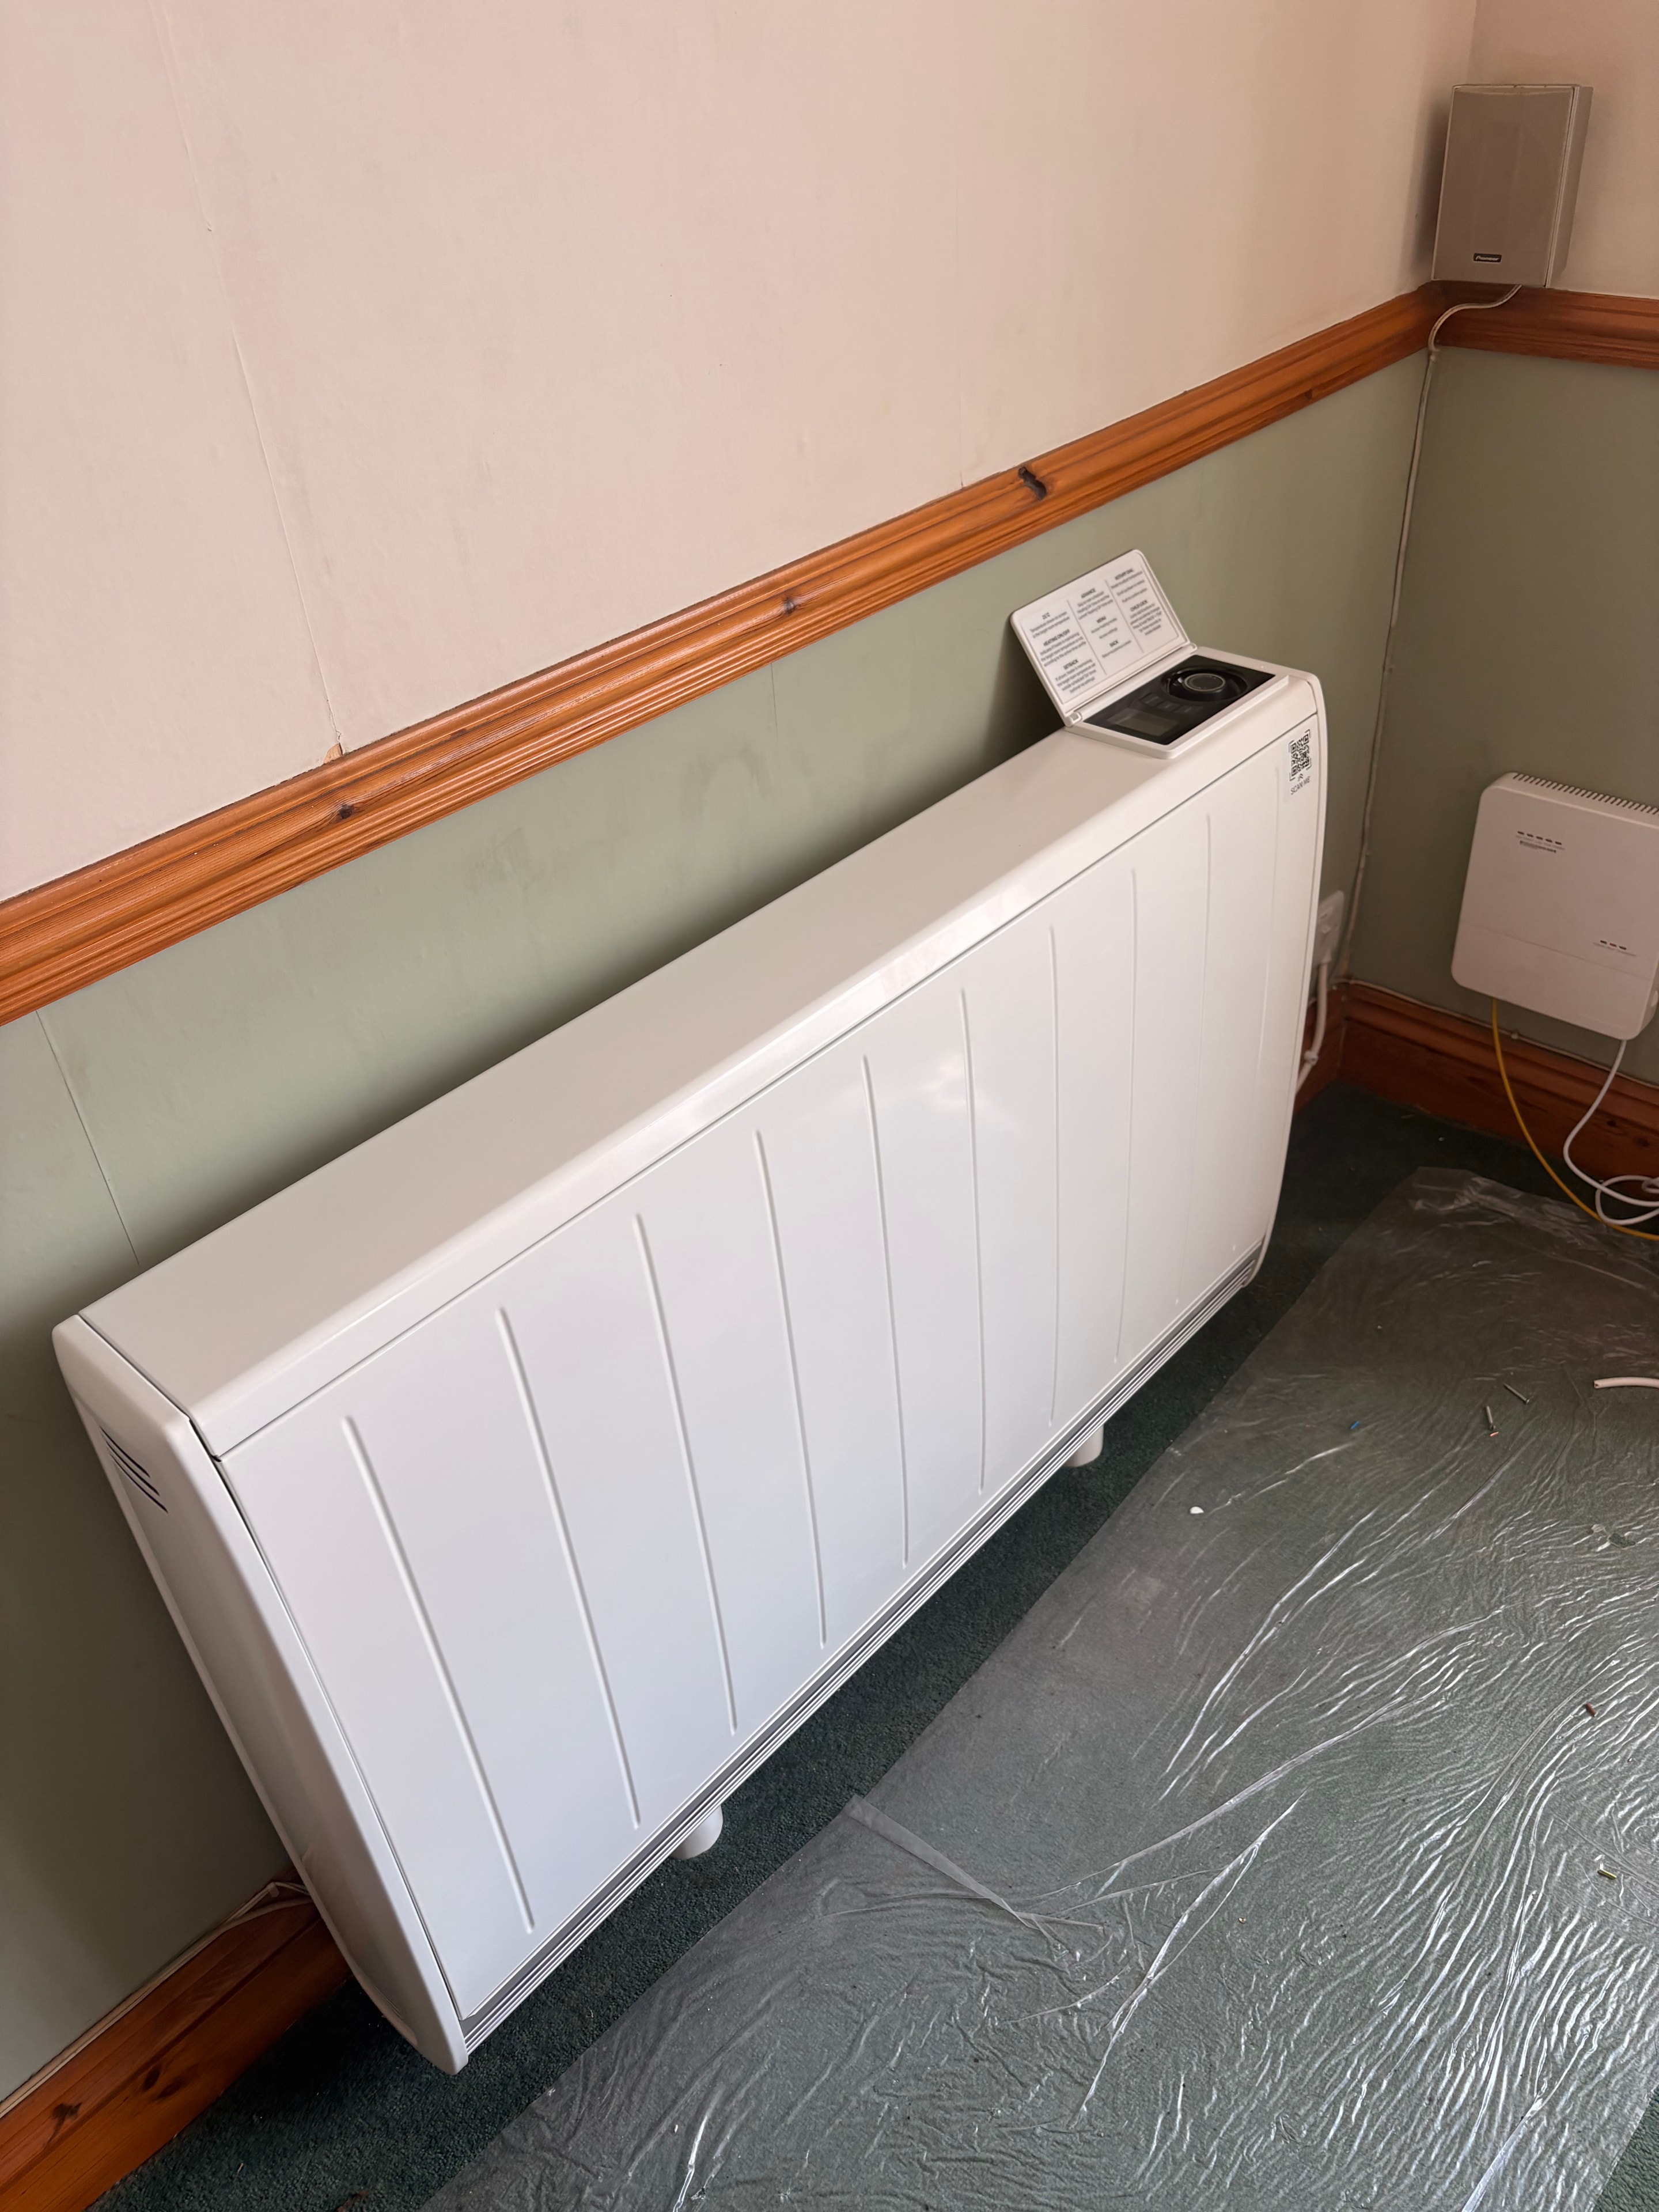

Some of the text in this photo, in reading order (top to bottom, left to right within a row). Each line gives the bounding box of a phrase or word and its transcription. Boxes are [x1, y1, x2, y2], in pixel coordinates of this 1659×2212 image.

[1109, 639, 1119, 647] BACK
[1063, 658, 1079, 670] SETBACK
[1290, 775, 1310, 795] SCAN ME
